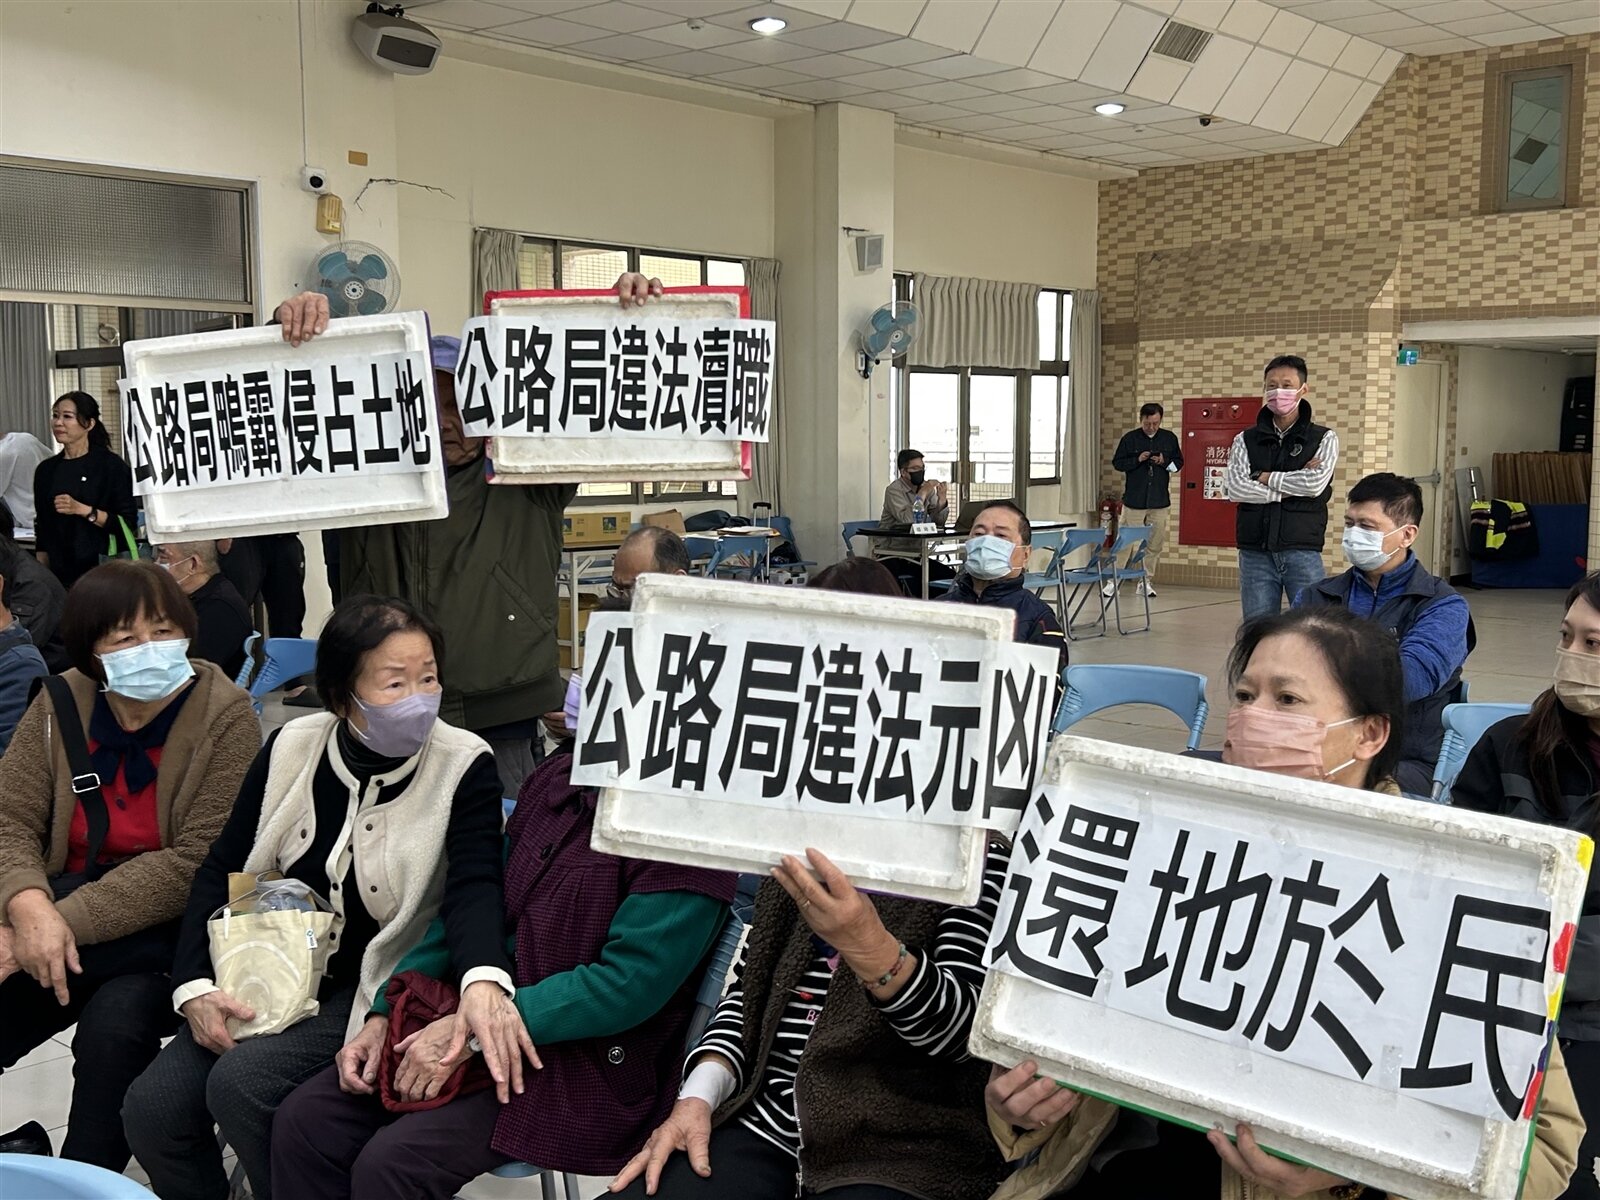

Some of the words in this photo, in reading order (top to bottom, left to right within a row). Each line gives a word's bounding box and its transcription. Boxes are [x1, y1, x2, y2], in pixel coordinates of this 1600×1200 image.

[126, 358, 431, 487] 公路局鴨霸侵占土地
[457, 324, 771, 436] 公路局違法瀆職
[579, 626, 1048, 820] 公路局違法元凶
[990, 793, 1552, 1122] 還地於民
